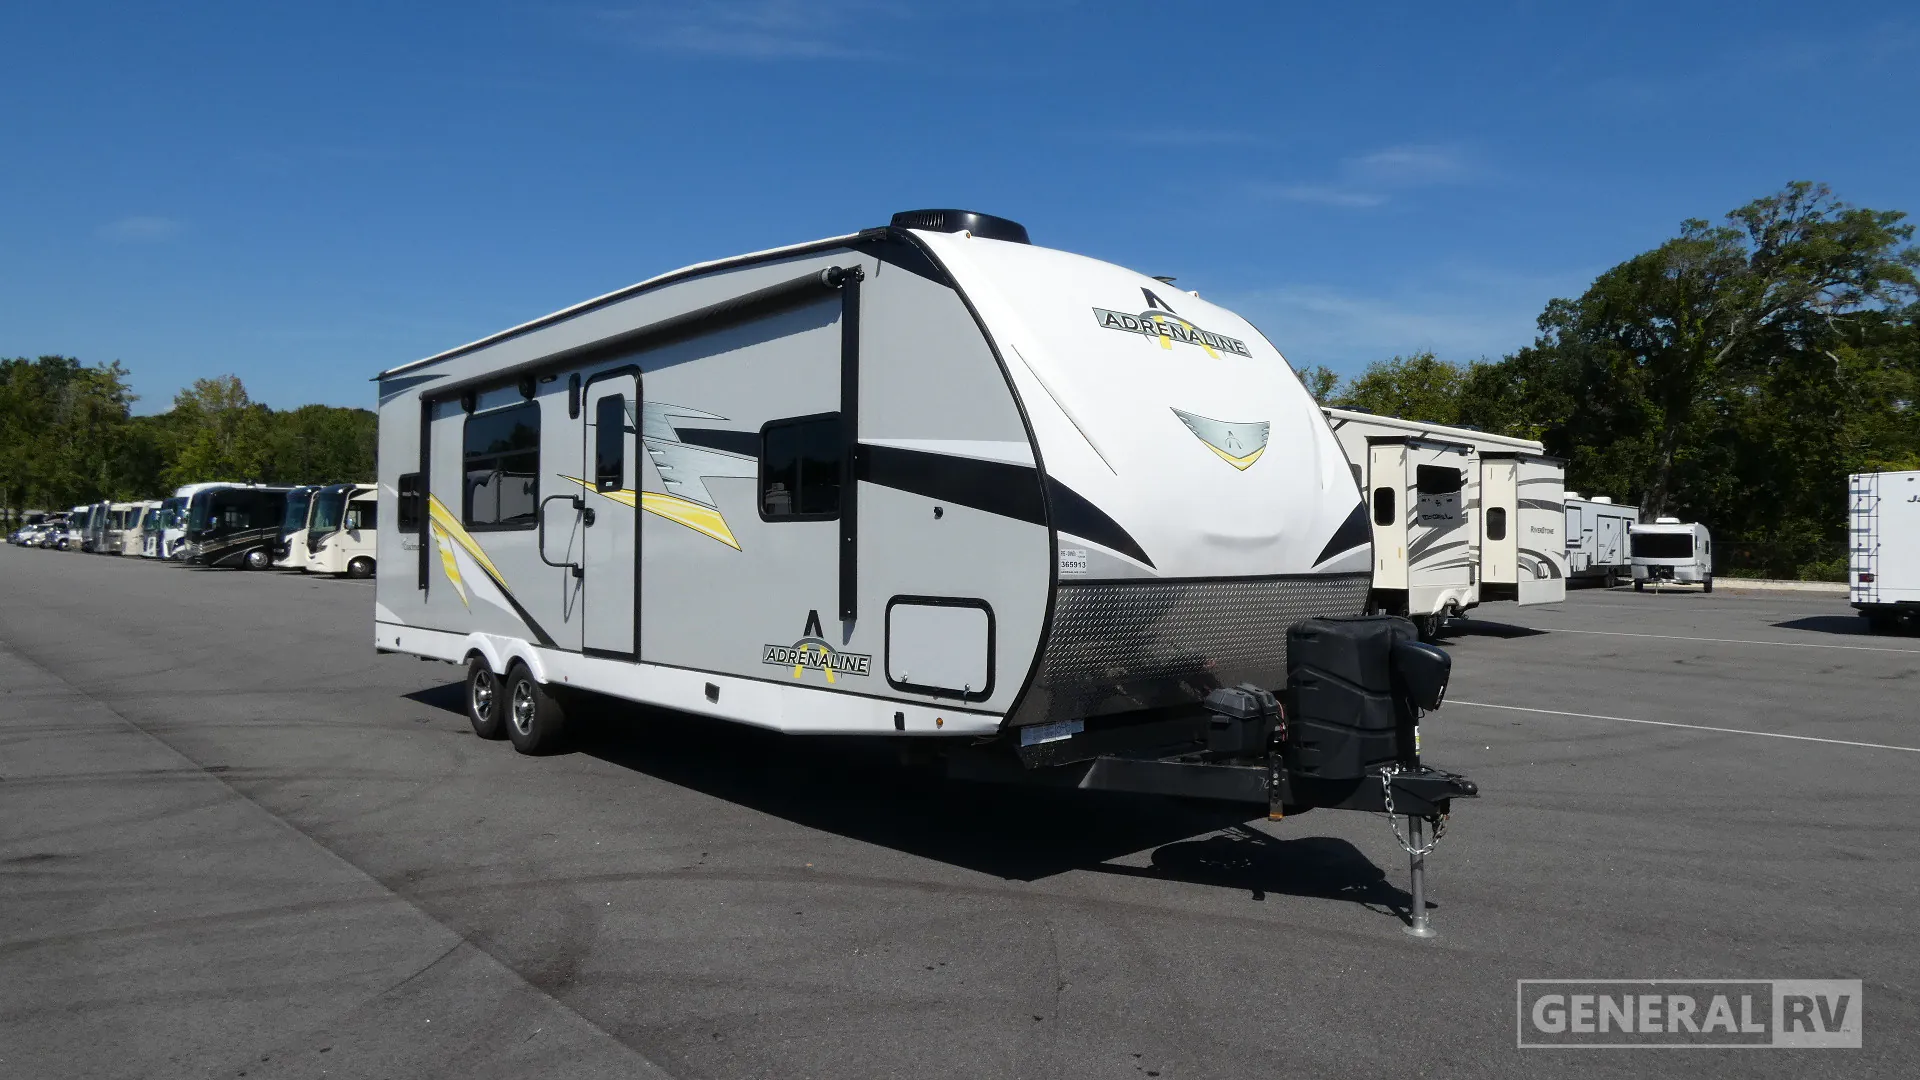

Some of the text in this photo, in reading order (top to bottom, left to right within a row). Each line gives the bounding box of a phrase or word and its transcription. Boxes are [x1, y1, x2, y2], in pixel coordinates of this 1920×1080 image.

[1105, 312, 1247, 354] ADRENALINE
[1061, 561, 1086, 569] 365913
[766, 648, 868, 673] ADRENALINE
